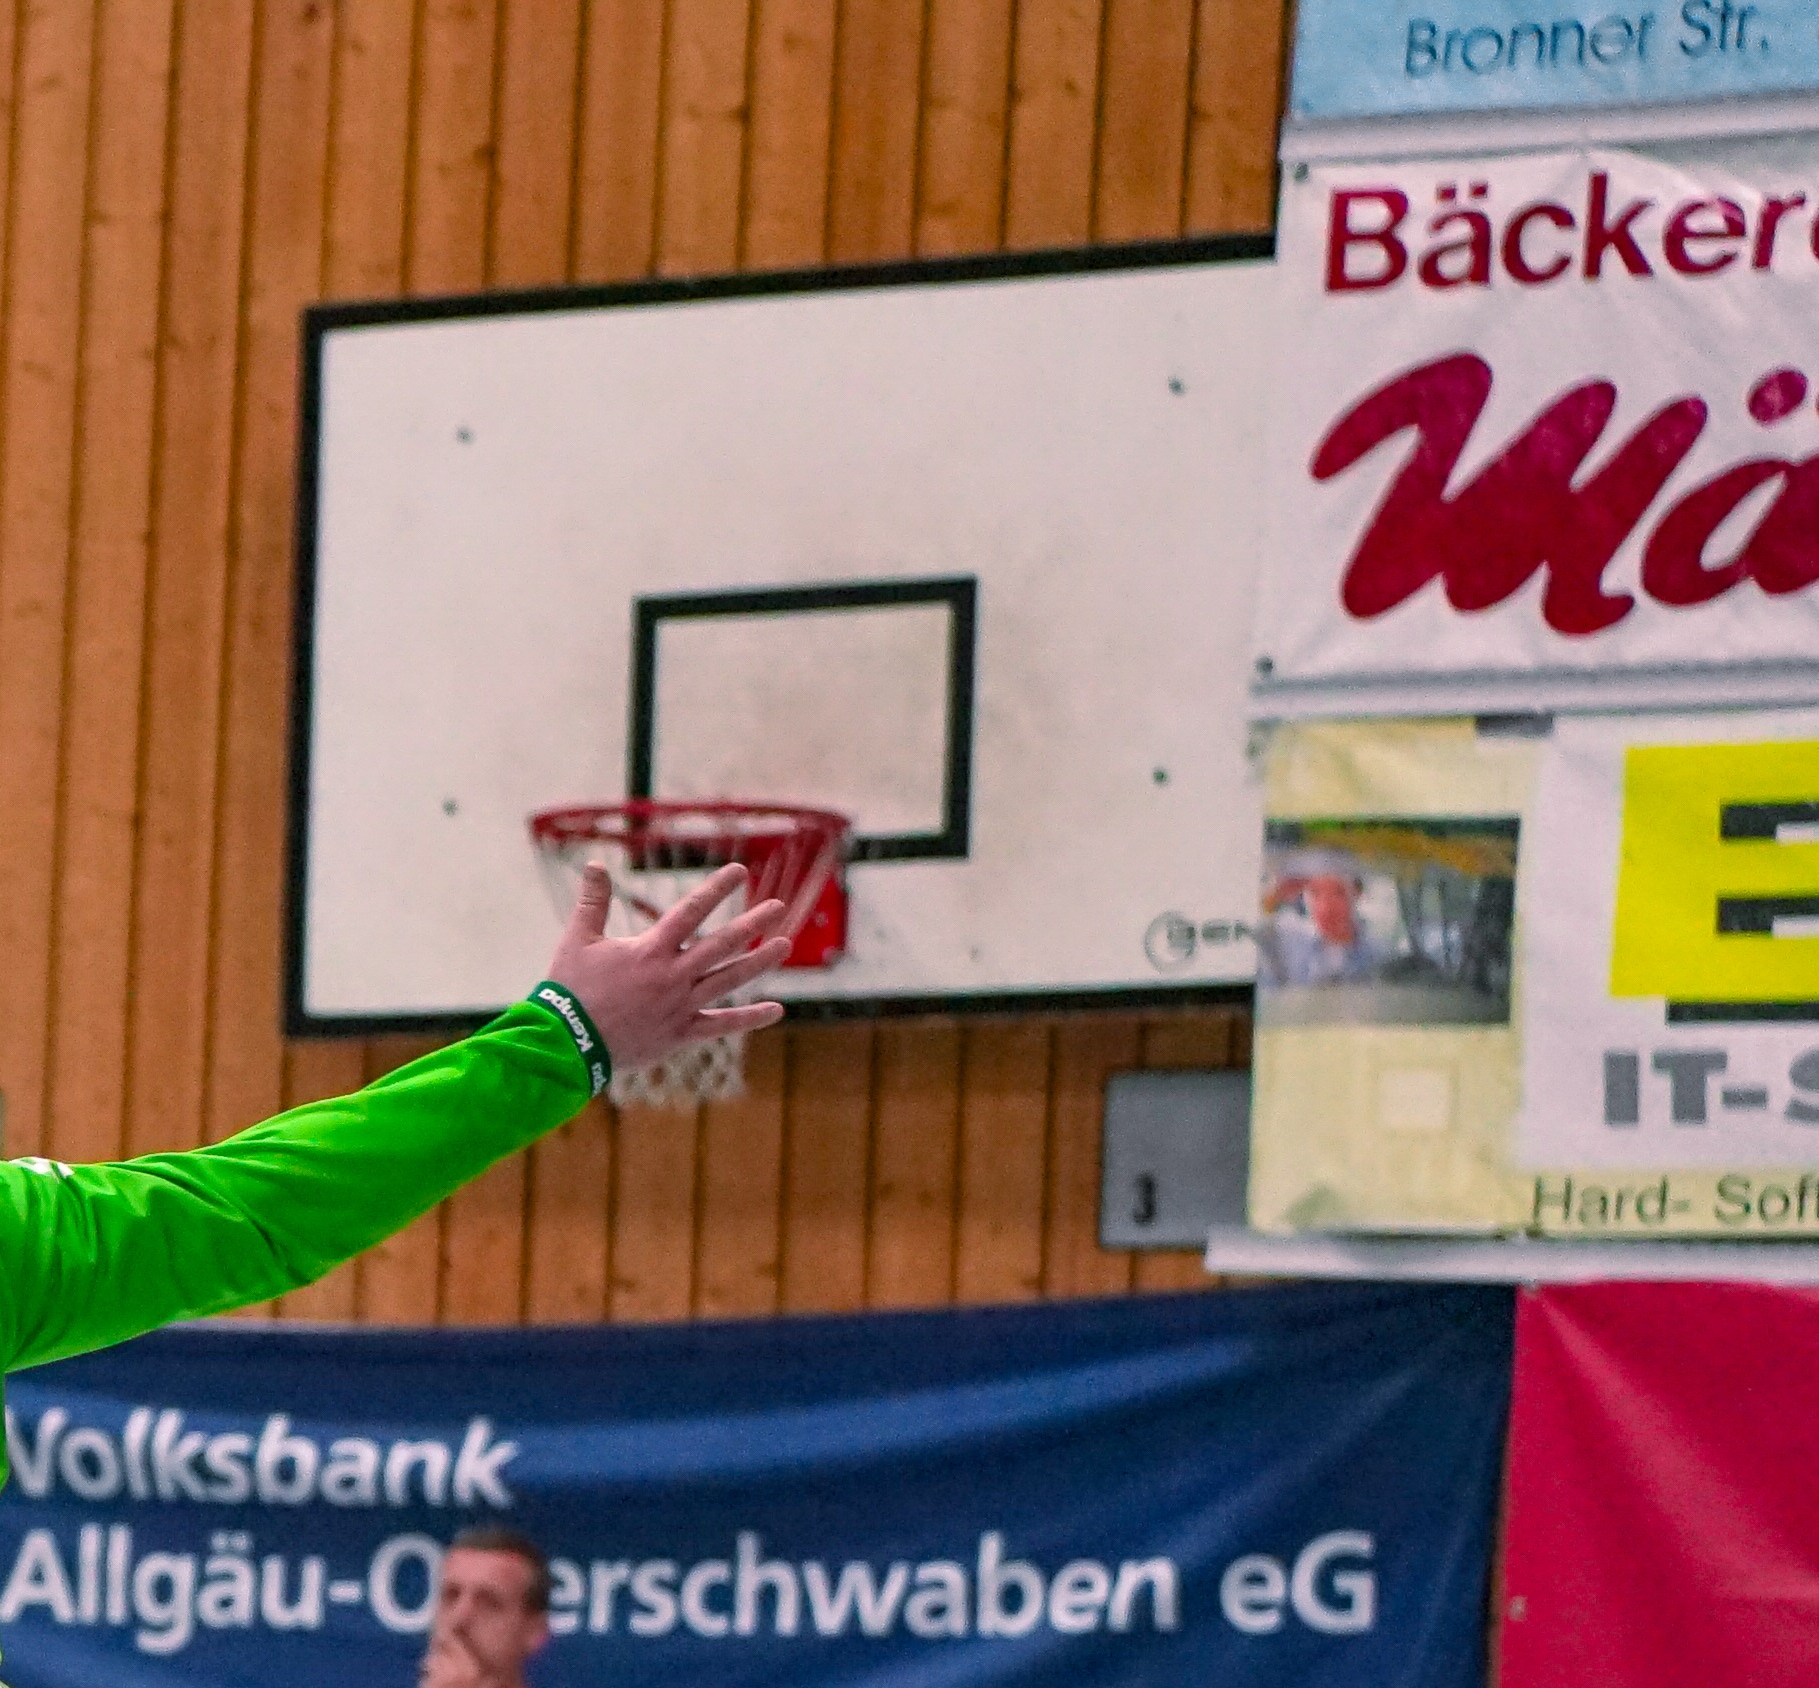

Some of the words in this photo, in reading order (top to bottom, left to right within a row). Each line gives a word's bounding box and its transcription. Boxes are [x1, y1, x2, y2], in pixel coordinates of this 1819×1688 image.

[1404, 13, 1655, 80] Bronner
[1324, 170, 1819, 293] Bäcker
[1714, 1172, 1819, 1226] Sof
[5, 1406, 519, 1506] Volksbank
[1221, 1528, 1377, 1637] eG
